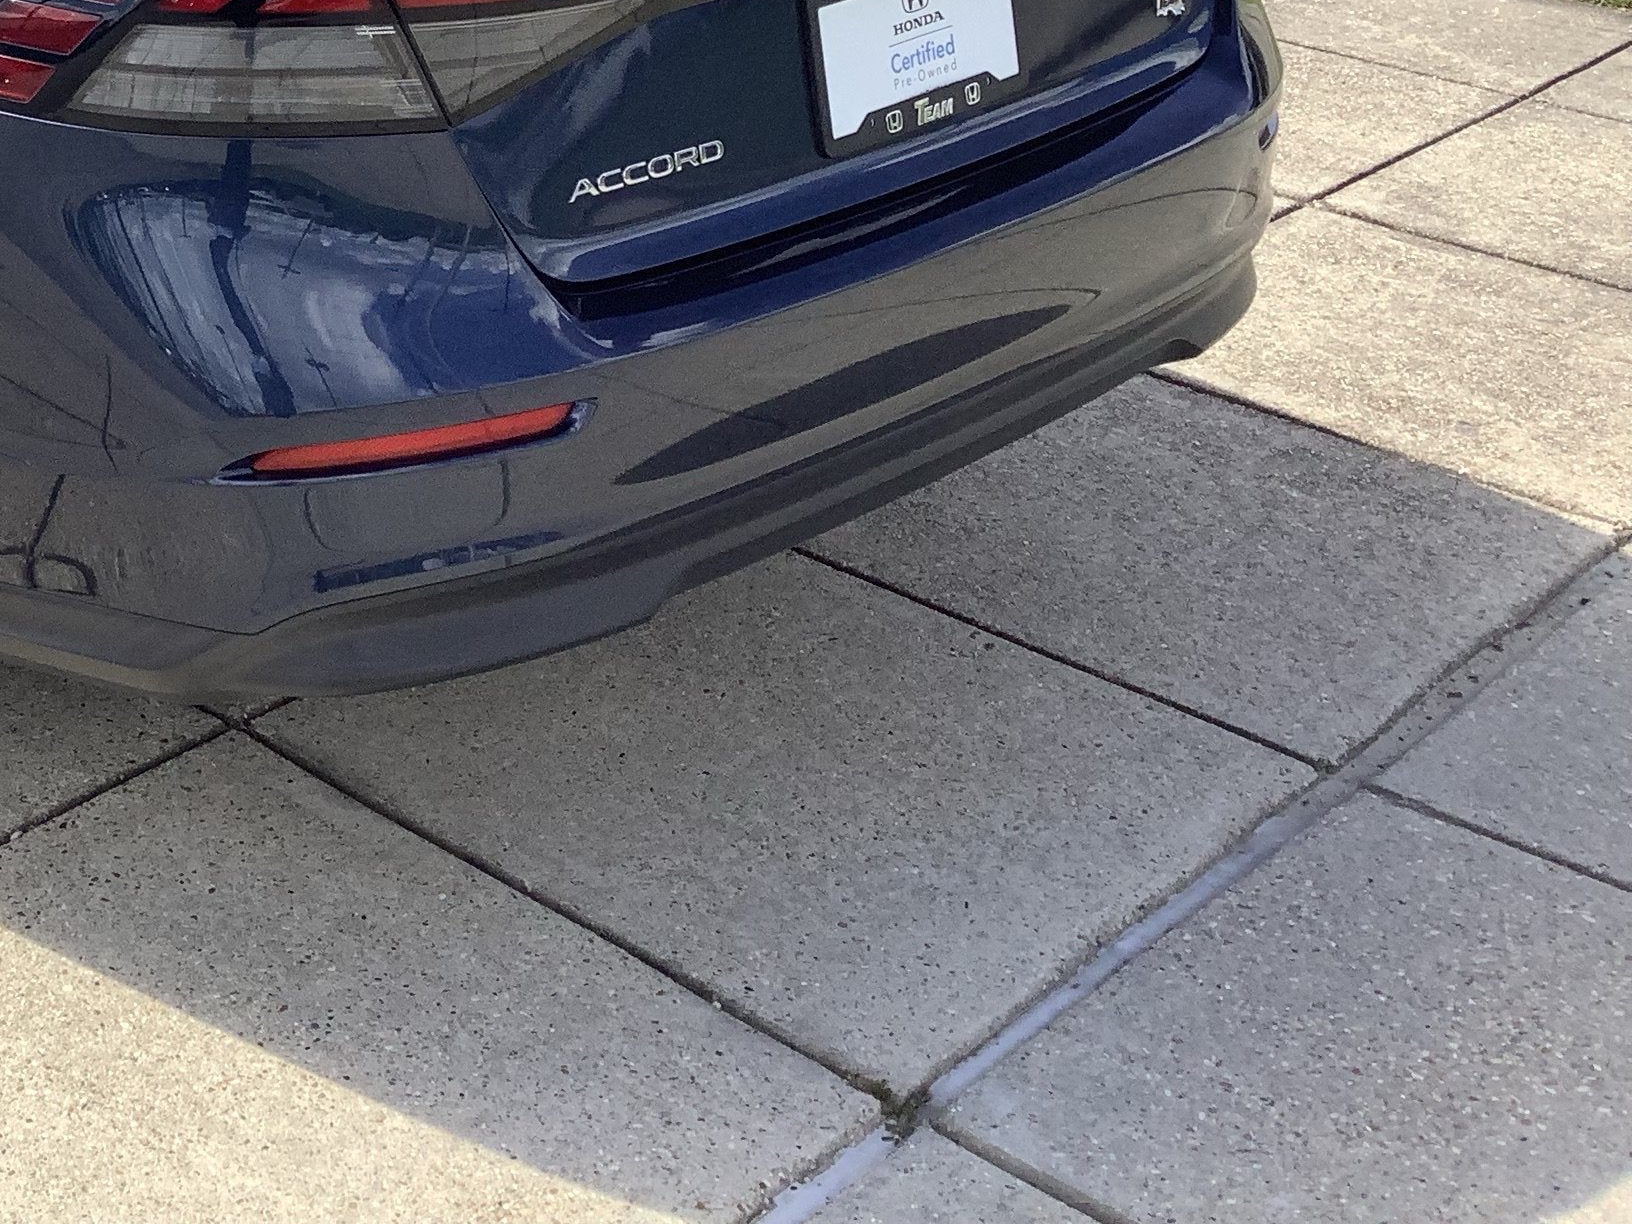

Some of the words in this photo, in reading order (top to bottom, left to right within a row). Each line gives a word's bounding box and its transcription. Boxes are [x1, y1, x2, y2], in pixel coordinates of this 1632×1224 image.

[893, 10, 945, 36] HONDA
[890, 33, 956, 74] Certified
[893, 58, 958, 90] Pre-Owned
[914, 97, 954, 126] TEAM
[568, 139, 725, 203] ACCORD
